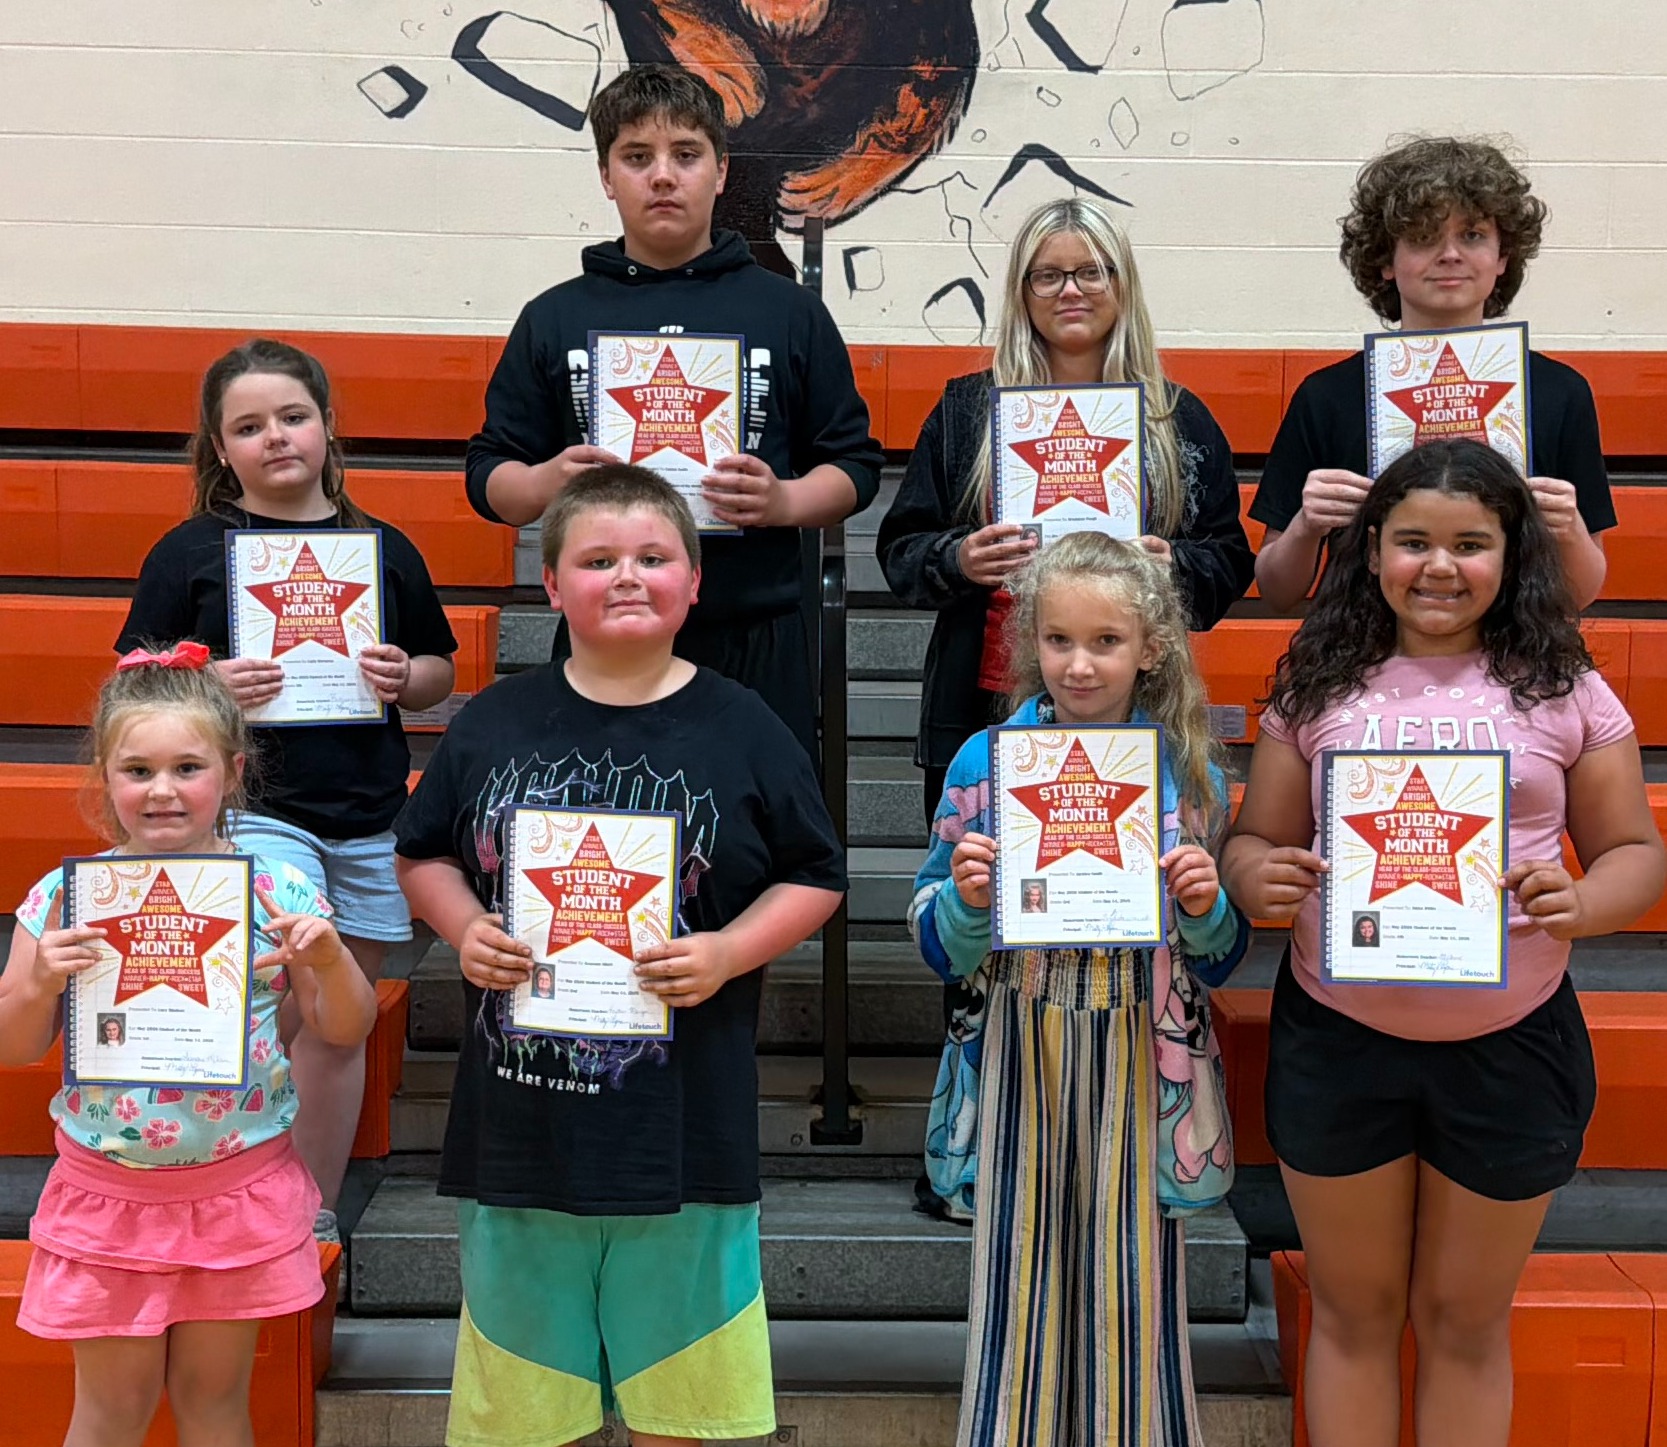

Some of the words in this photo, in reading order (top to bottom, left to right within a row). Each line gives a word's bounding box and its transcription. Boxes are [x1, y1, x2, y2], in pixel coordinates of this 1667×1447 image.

[1437, 366, 1460, 375] BRIGHT
[1432, 375, 1465, 384] AWESOME
[633, 387, 706, 403] STUDENT
[1413, 384, 1489, 403] STUDENT
[1434, 400, 1445, 408] OF
[1449, 398, 1467, 407] THE
[642, 409, 694, 422] MONTH
[1422, 407, 1478, 423] MONTH
[638, 423, 698, 432] ACHIEVEMENT
[1419, 420, 1481, 434] ACHIEVEMENT
[1035, 438, 1107, 455] STUDENT
[1044, 461, 1096, 473] MONTH
[1041, 474, 1099, 483] ACHIEVEMENT
[273, 583, 345, 597] STUDENT
[282, 604, 335, 616] MONTH
[279, 617, 338, 626] ACHIEVEMENT
[1339, 688, 1400, 723] WEST
[1424, 686, 1517, 724] COAST
[1360, 714, 1501, 750] AERO
[1059, 773, 1095, 781] AWESOME
[1039, 784, 1120, 801] STUDENT
[1076, 798, 1096, 806] THE
[1396, 802, 1435, 810] AWESOME
[1049, 808, 1108, 822] MONTH
[1374, 812, 1462, 830] STUDENT
[1045, 823, 1112, 834] ACHIEVEMENT
[1398, 829, 1411, 837] OF
[1414, 829, 1435, 837] THE
[1385, 839, 1448, 853] MONTH
[579, 850, 605, 858] BRIGHT
[572, 859, 610, 868] AWESOME
[1380, 855, 1452, 865] ACHIEVEMENT
[552, 869, 635, 888] STUDENT
[589, 886, 609, 894] THE
[1432, 882, 1458, 890] SWEET
[561, 894, 621, 910] MONTH
[142, 905, 182, 913] AWESOME
[556, 911, 624, 922] ACHIEVEMENT
[119, 915, 209, 933] STUDENT
[144, 932, 158, 940] OF
[161, 932, 182, 940] THE
[552, 936, 572, 944] SHINE
[604, 938, 629, 946] SWEET
[130, 941, 195, 955] MONTH
[126, 957, 198, 968] ACHIEVEMENT
[178, 984, 204, 992] SWEET
[204, 1071, 236, 1079] Lifetouch
[497, 1066, 512, 1079] WE
[517, 1073, 541, 1086] ARE
[548, 1078, 600, 1094] VENOM
